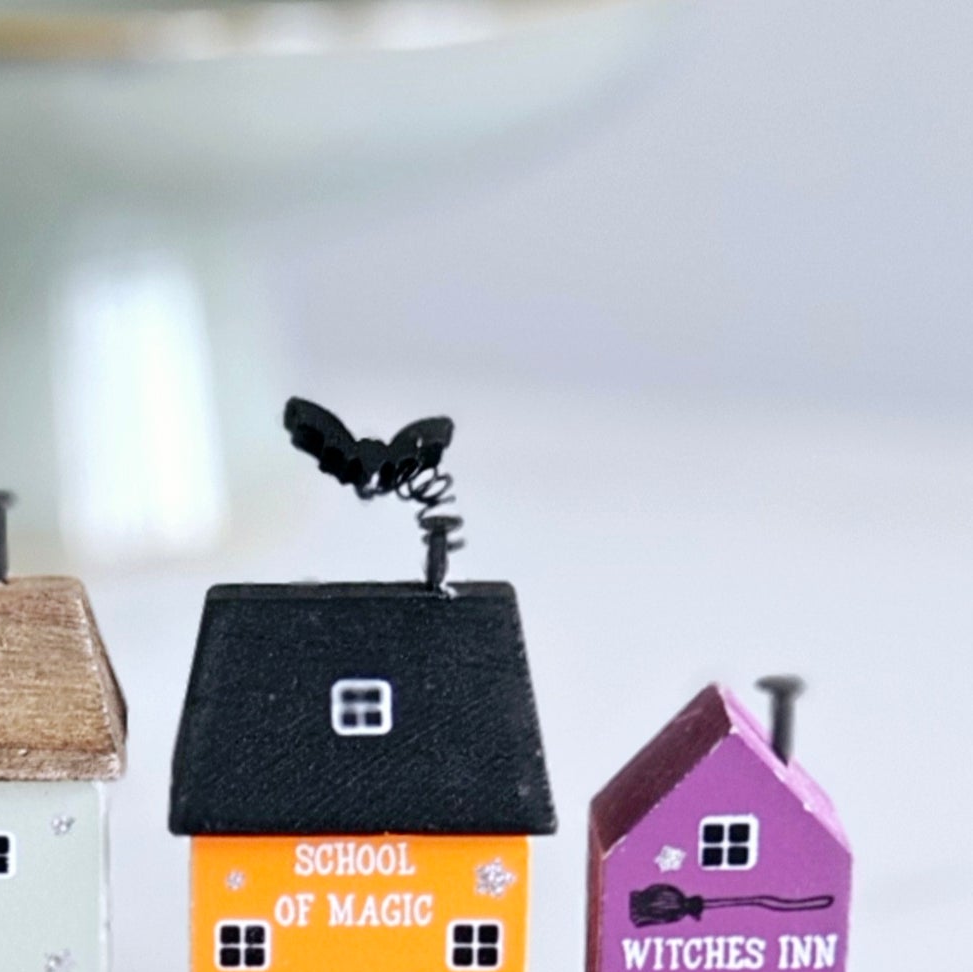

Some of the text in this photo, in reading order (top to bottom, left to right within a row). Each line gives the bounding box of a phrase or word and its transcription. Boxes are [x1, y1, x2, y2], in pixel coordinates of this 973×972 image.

[294, 842, 416, 877] SCHOOL
[273, 892, 433, 928] OF MAGIC
[621, 934, 838, 971] WITCHES INN
